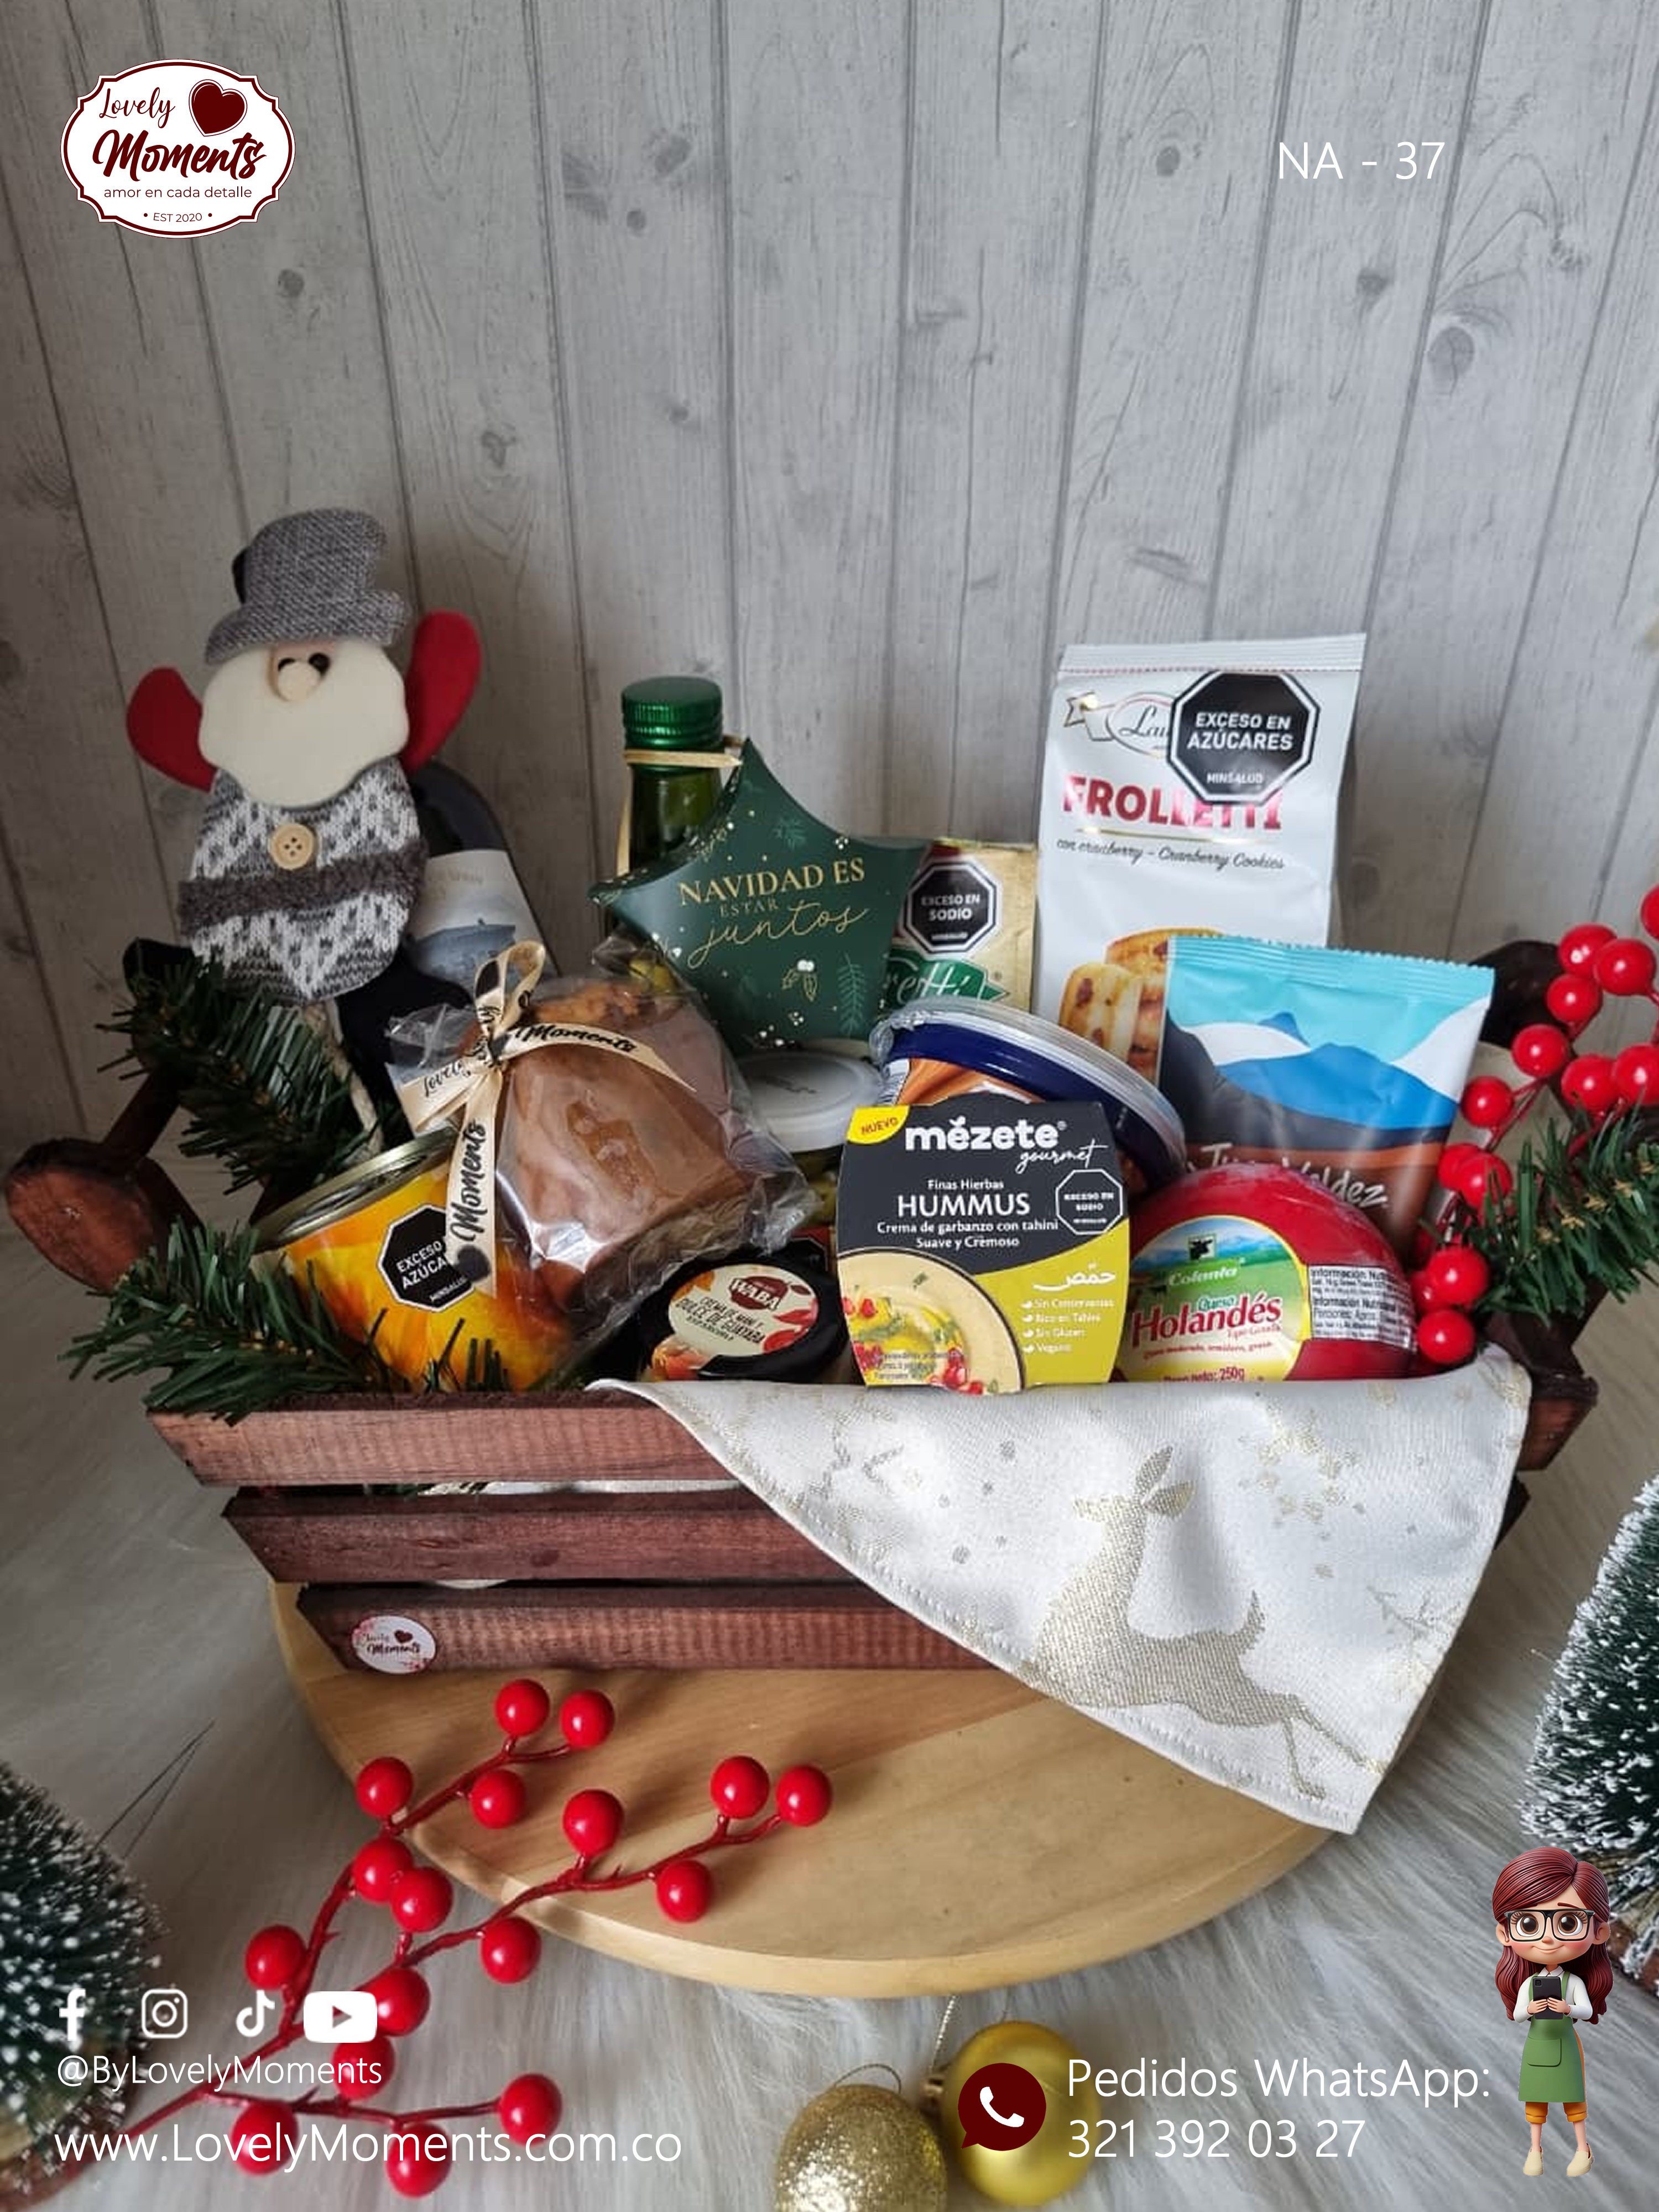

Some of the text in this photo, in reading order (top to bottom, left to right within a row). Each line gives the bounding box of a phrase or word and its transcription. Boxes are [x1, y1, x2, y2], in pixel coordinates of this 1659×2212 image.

[1195, 712, 1291, 730] EXCESO EN
[1187, 727, 1293, 750] AZÚCARES
[1158, 846, 1230, 871] Cranberry
[1233, 852, 1285, 870] Cookies
[679, 857, 865, 906] NAVIDAD ES
[719, 898, 779, 918] ESTAR
[965, 893, 981, 905] EN
[929, 907, 973, 921] SODIO
[687, 899, 870, 969] juntos
[514, 1024, 638, 1053] Moments
[860, 1117, 899, 1135] NUEVO
[1014, 1138, 1109, 1175] gourmet
[450, 1118, 489, 1242] Moments
[927, 1178, 1005, 1191] Finas Hierbas
[1282, 1156, 1388, 1208] ldez
[897, 1192, 1031, 1217] HUMMUS
[877, 1221, 917, 1234] Crema
[920, 1220, 936, 1234] de
[938, 1220, 994, 1238] garbanzo
[997, 1222, 1019, 1233] con
[1020, 1218, 1060, 1232] tahini
[916, 1236, 1020, 1251] Suave y Cremoso
[395, 1240, 442, 1274] EXCESO
[400, 1255, 447, 1290] AZÚCA
[1131, 1291, 1282, 1348] Holandés
